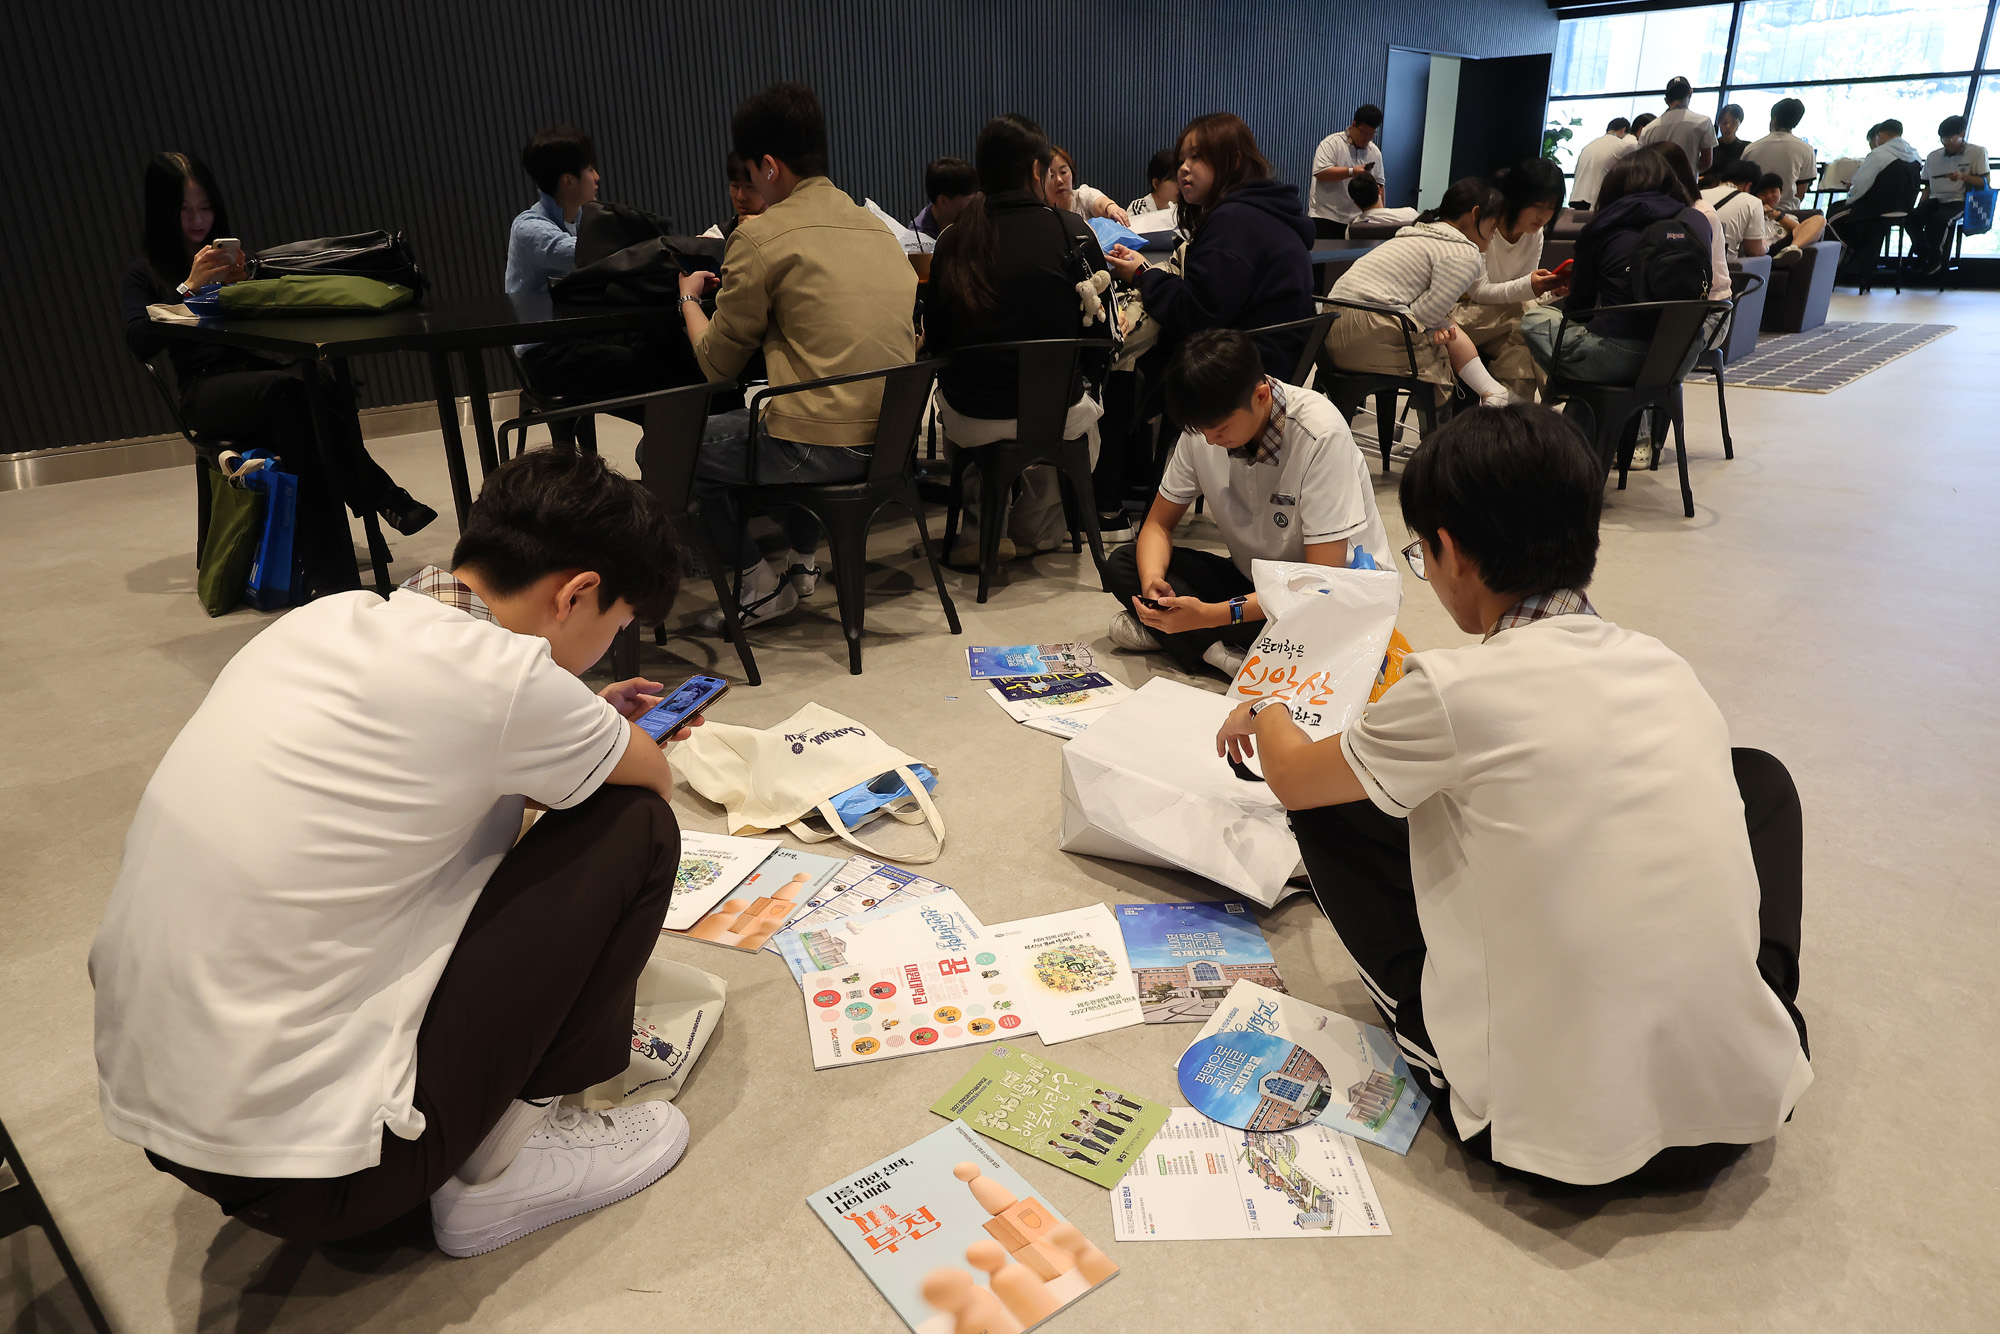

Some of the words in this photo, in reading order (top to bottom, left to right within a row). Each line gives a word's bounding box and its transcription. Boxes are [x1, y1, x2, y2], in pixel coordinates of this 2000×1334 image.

[1257, 637, 1305, 659] 문대학은
[1238, 655, 1334, 705] 신안산
[1291, 706, 1322, 726] 학교
[1171, 949, 1228, 957] 국제대학교
[938, 956, 971, 977] 꿈
[903, 963, 928, 1006] 대원대학교
[1069, 1003, 1107, 1016] 2027학년도
[1195, 1045, 1233, 1086] 평택으로
[1213, 1048, 1248, 1089] 국제대로
[1229, 1056, 1262, 1096] 국제대학교
[826, 1182, 855, 1205] 나를
[854, 1170, 884, 1191] 위한
[882, 1157, 914, 1177] 선택,
[1122, 1186, 1130, 1197] 안내
[834, 1194, 864, 1215] 나의
[863, 1181, 892, 1202] 미래
[1123, 1198, 1132, 1208] 학과
[1245, 1198, 1254, 1209] 안내
[1248, 1210, 1257, 1220] 시설
[864, 1205, 942, 1255] 부천
